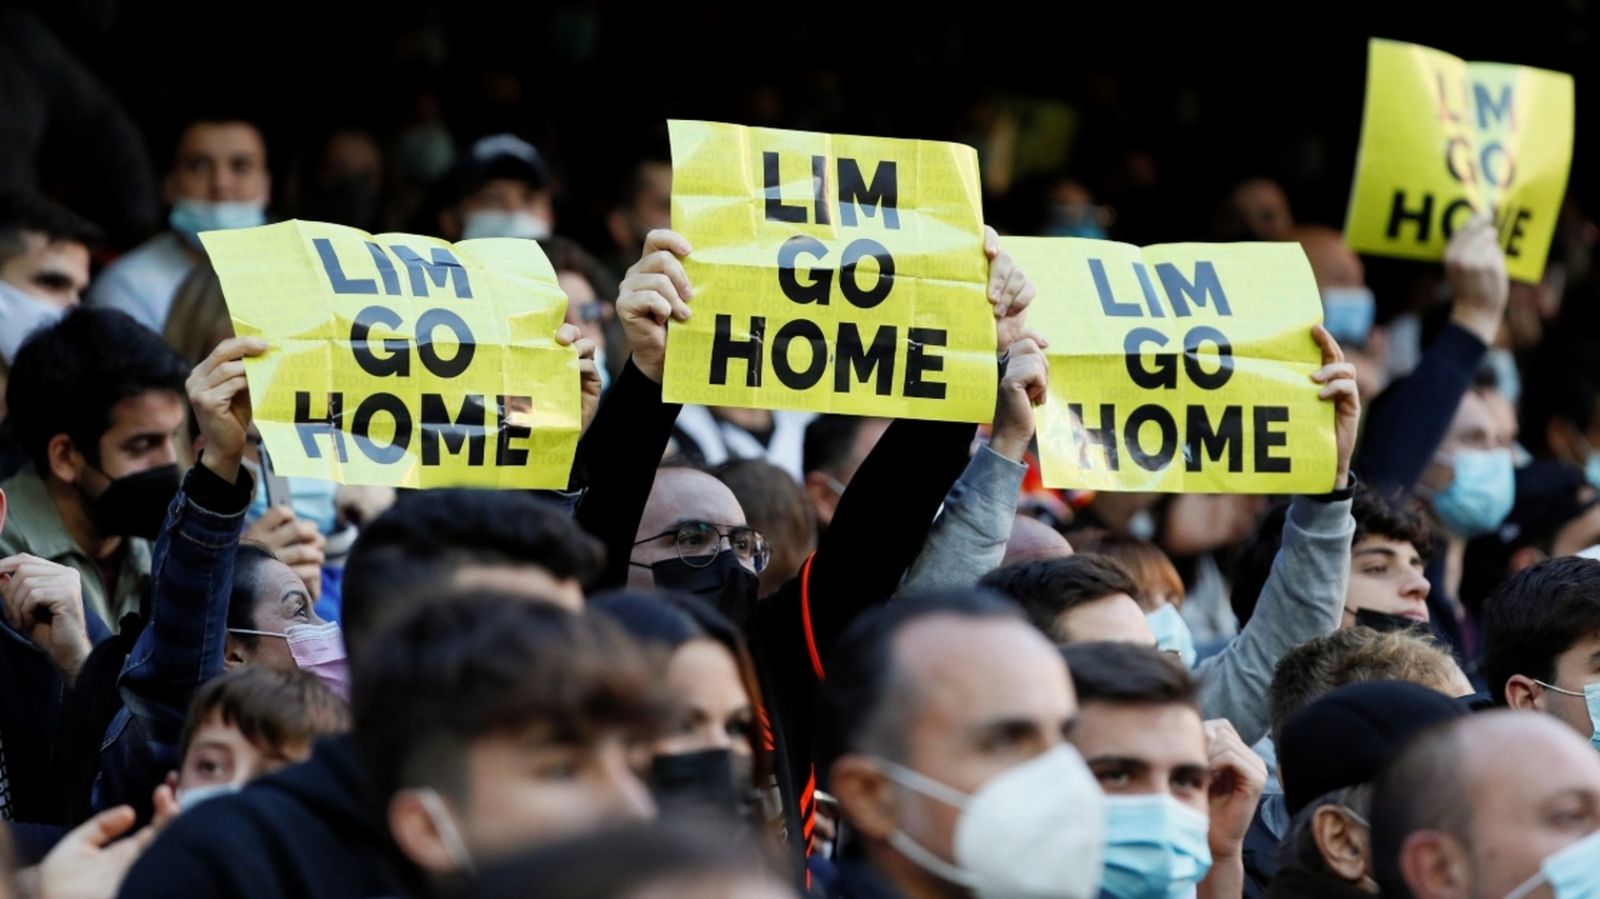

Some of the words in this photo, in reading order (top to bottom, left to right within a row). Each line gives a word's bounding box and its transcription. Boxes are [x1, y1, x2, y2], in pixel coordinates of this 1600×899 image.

[763, 152, 899, 229] LIM
[1446, 136, 1517, 190] GO
[1387, 189, 1531, 256] HOE
[312, 238, 472, 298] LIM
[778, 239, 895, 309] GO
[1088, 259, 1231, 317] LIM
[349, 306, 476, 378] GO
[709, 313, 947, 400] HOME
[1124, 326, 1233, 390] GO
[294, 391, 532, 467] HOME
[1068, 403, 1291, 473] HOME
